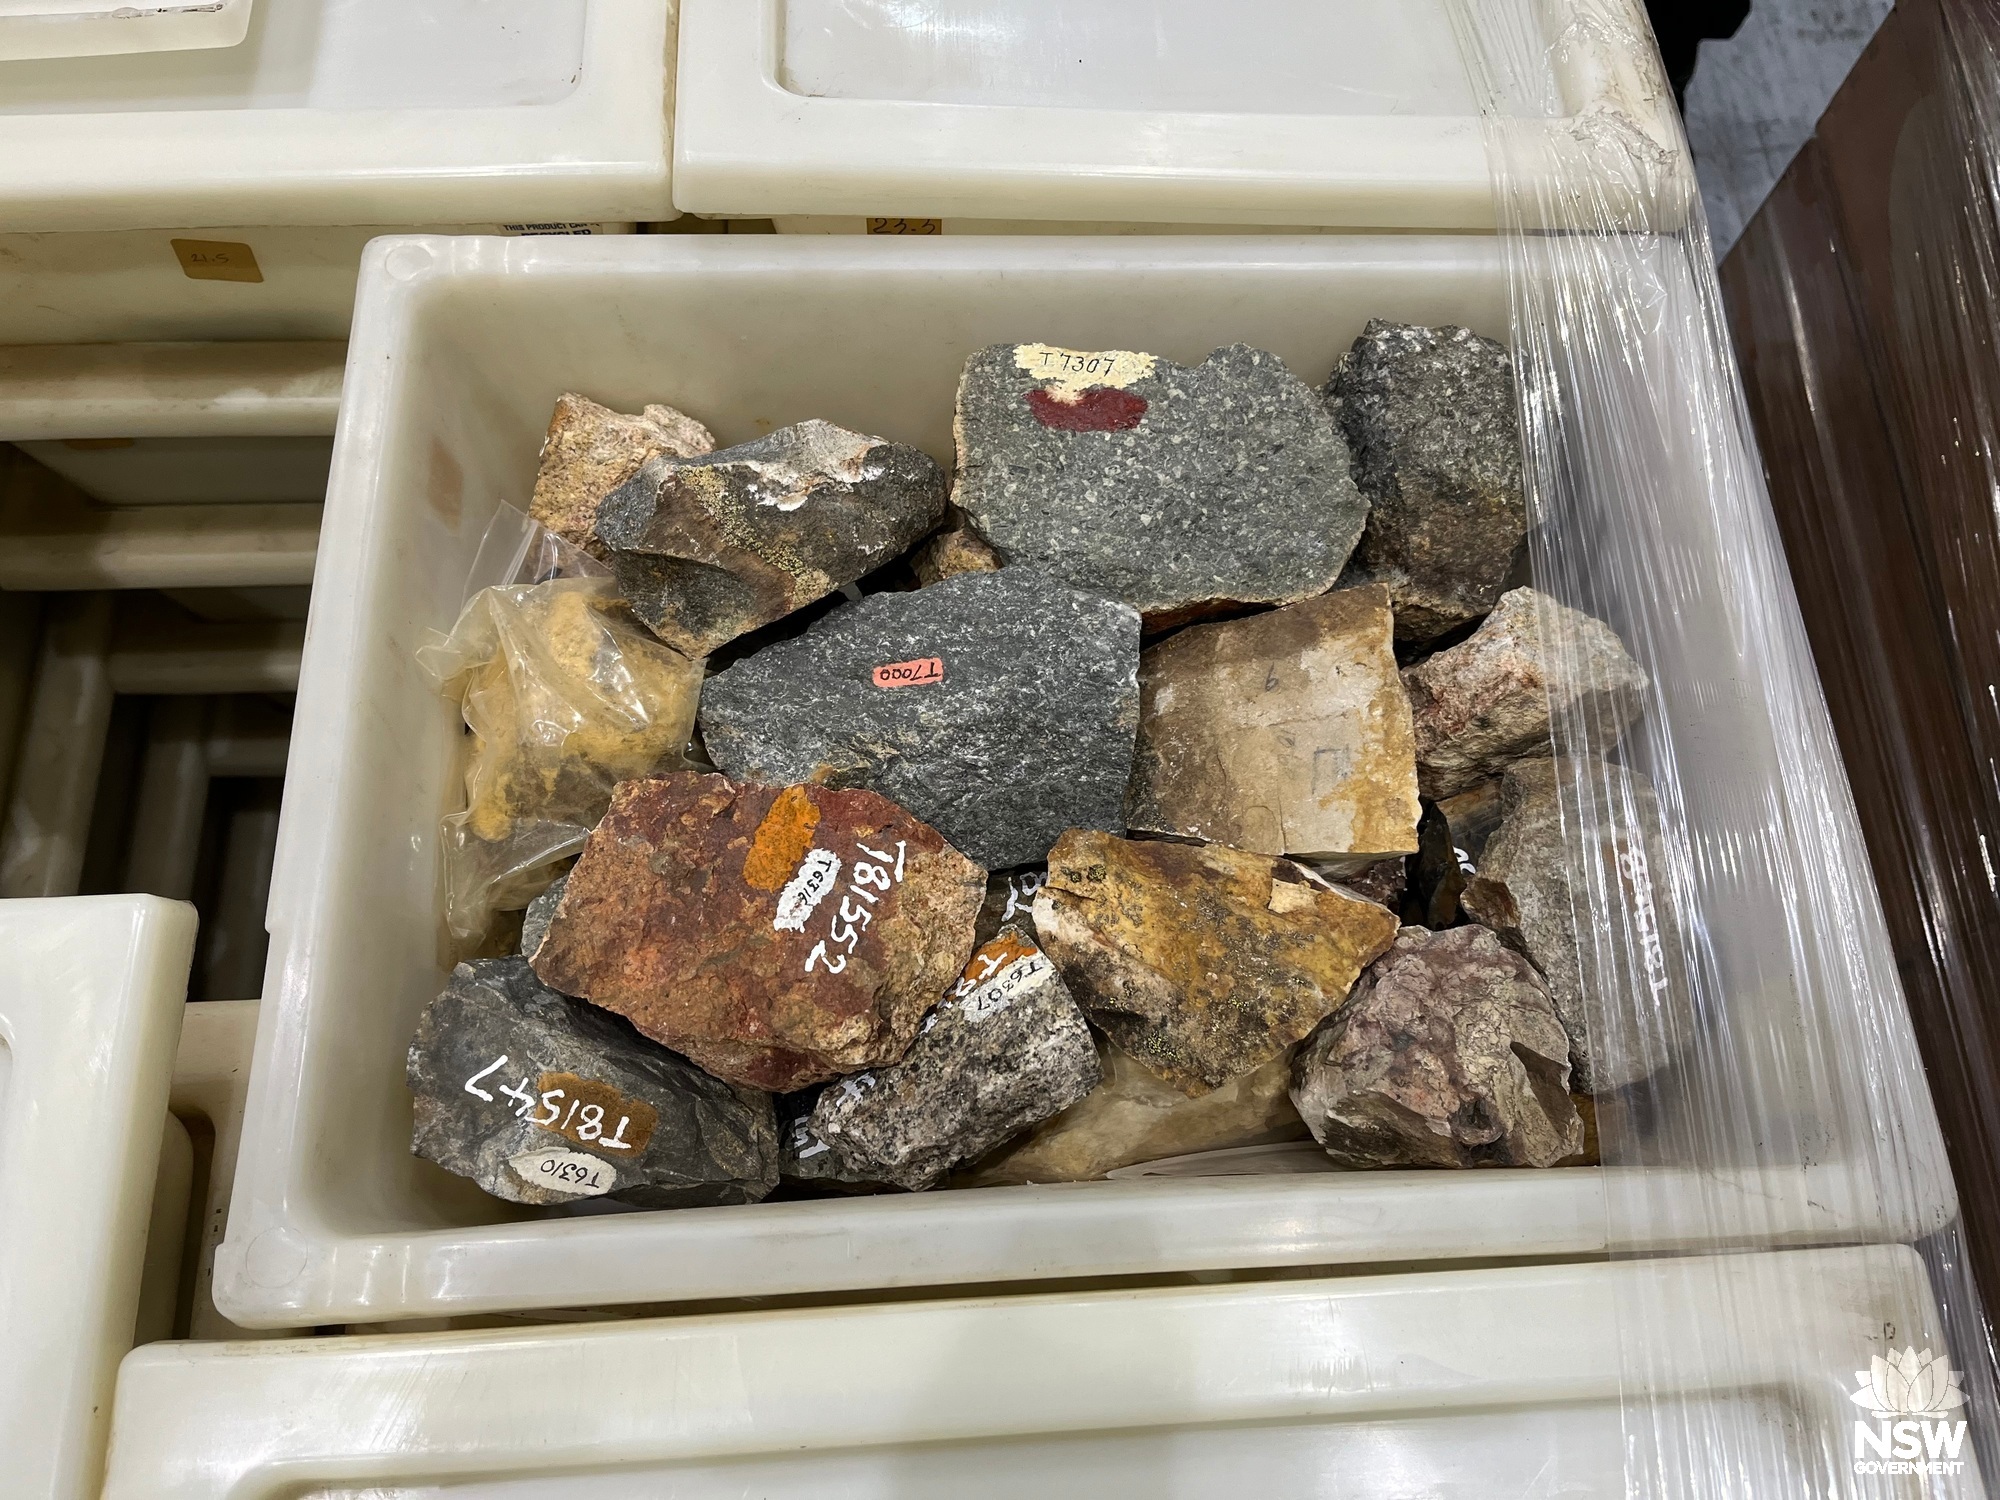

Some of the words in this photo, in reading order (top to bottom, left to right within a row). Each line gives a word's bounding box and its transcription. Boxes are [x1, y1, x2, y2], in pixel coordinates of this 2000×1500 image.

[525, 223, 566, 231] PRODUCT
[879, 662, 942, 681] T7000
[804, 840, 906, 975] T81552
[977, 962, 1044, 1011] T6307
[464, 1054, 632, 1150] T81547
[540, 1159, 600, 1189] T6310
